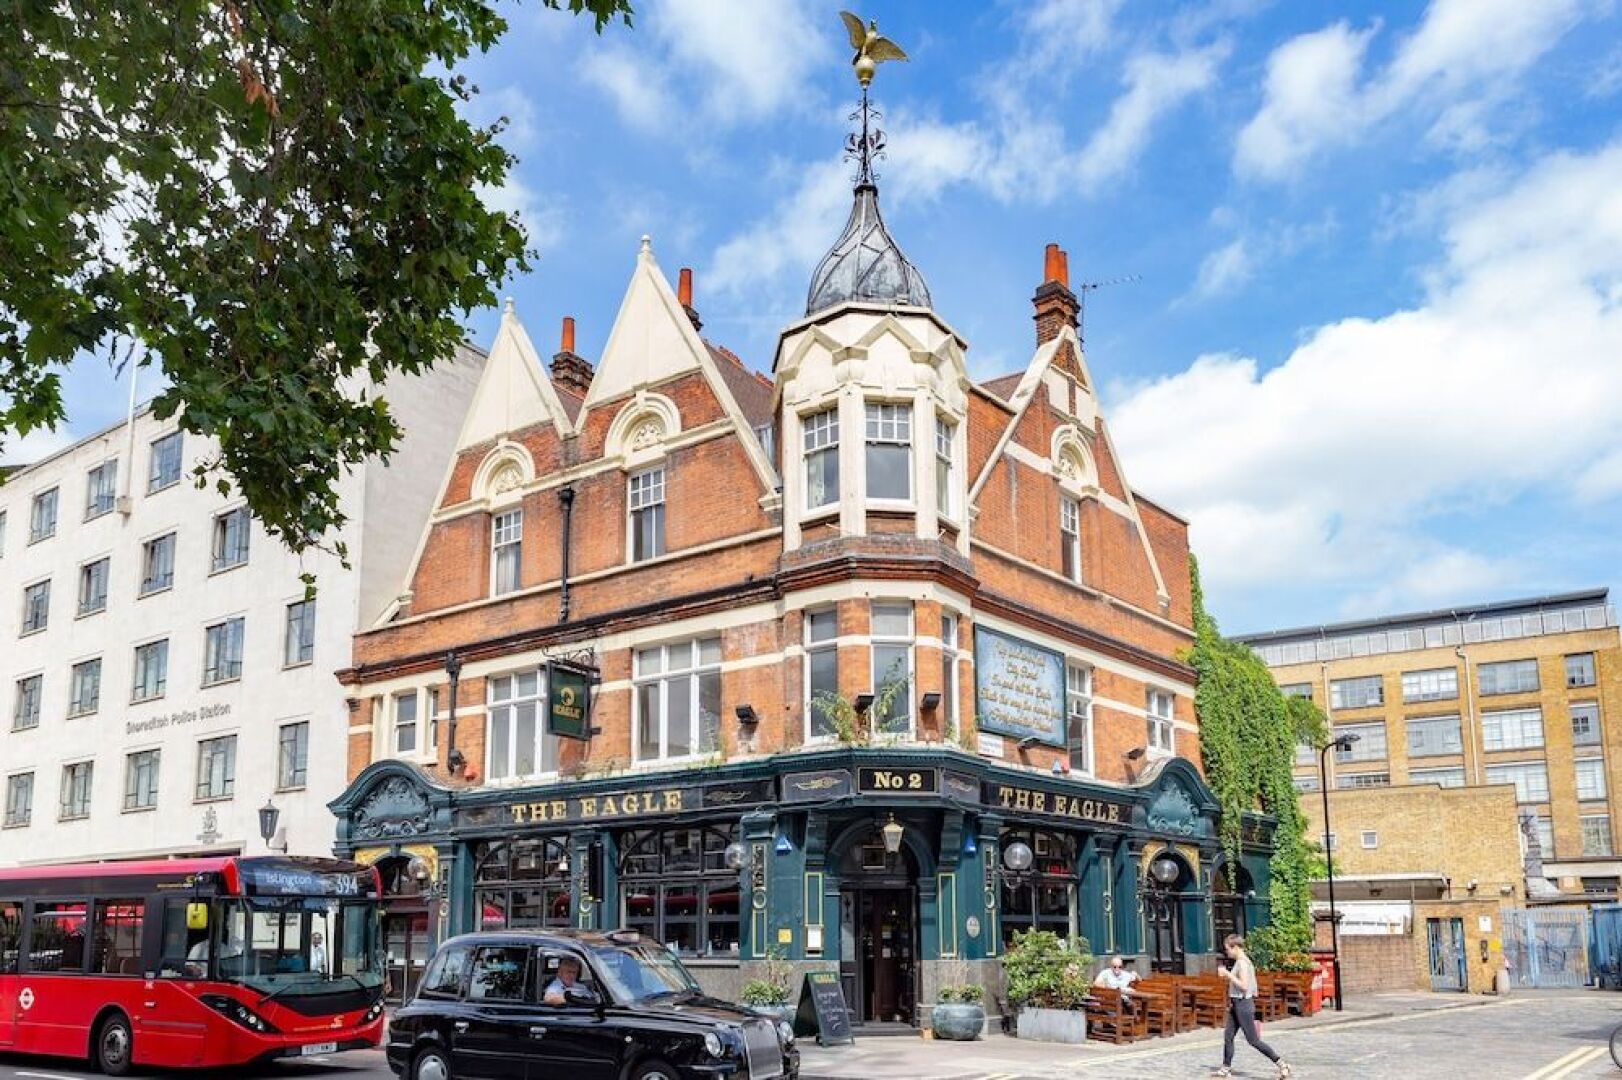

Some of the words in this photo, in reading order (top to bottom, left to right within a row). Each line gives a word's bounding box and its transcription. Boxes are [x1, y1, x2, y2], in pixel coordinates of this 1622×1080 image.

[171, 709, 197, 726] Police
[199, 703, 231, 721] Station
[874, 771, 904, 788] No
[908, 772, 921, 788] 2
[511, 801, 567, 823] THE
[580, 791, 682, 818] EAGLE
[1000, 788, 1045, 812] THE
[1054, 795, 1119, 822] EAGLE
[335, 873, 358, 894] 394
